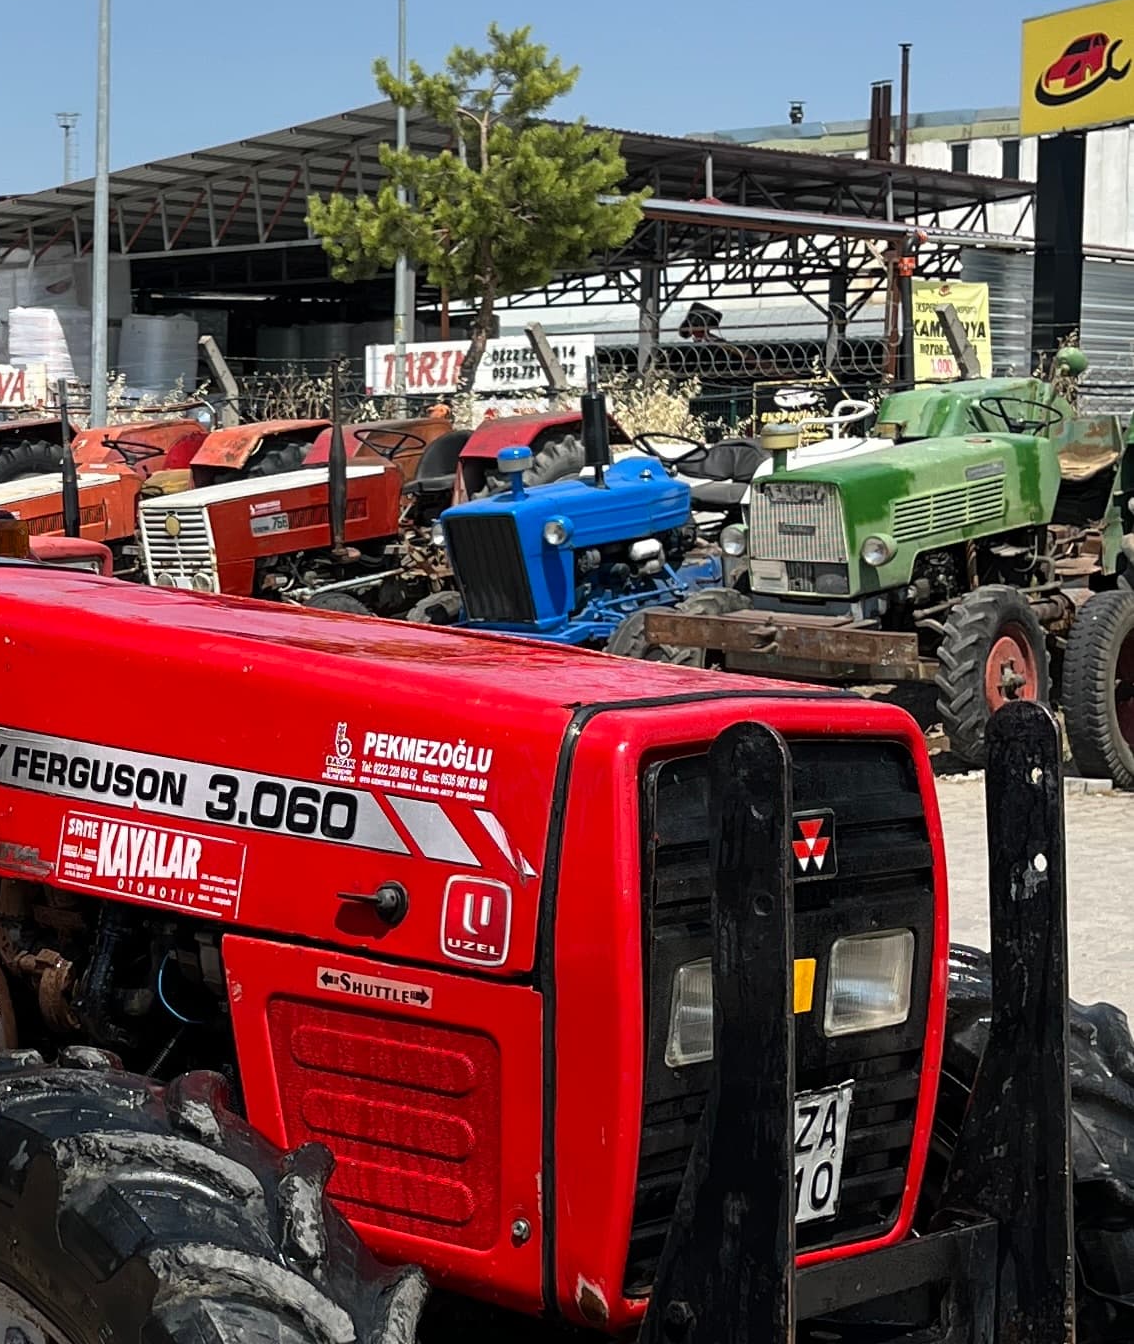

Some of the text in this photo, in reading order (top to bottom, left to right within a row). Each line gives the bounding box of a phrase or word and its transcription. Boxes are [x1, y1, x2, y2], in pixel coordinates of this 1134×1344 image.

[914, 319, 987, 338] KAMNYA
[363, 731, 494, 774] PEKMEZOĞLU
[11, 746, 187, 806] FERGUSON
[204, 772, 358, 841] 3.060
[67, 817, 99, 840] SAME
[96, 821, 202, 880] KAYALAR
[117, 877, 195, 905] OTOMOTİV
[447, 937, 501, 956] UZEL
